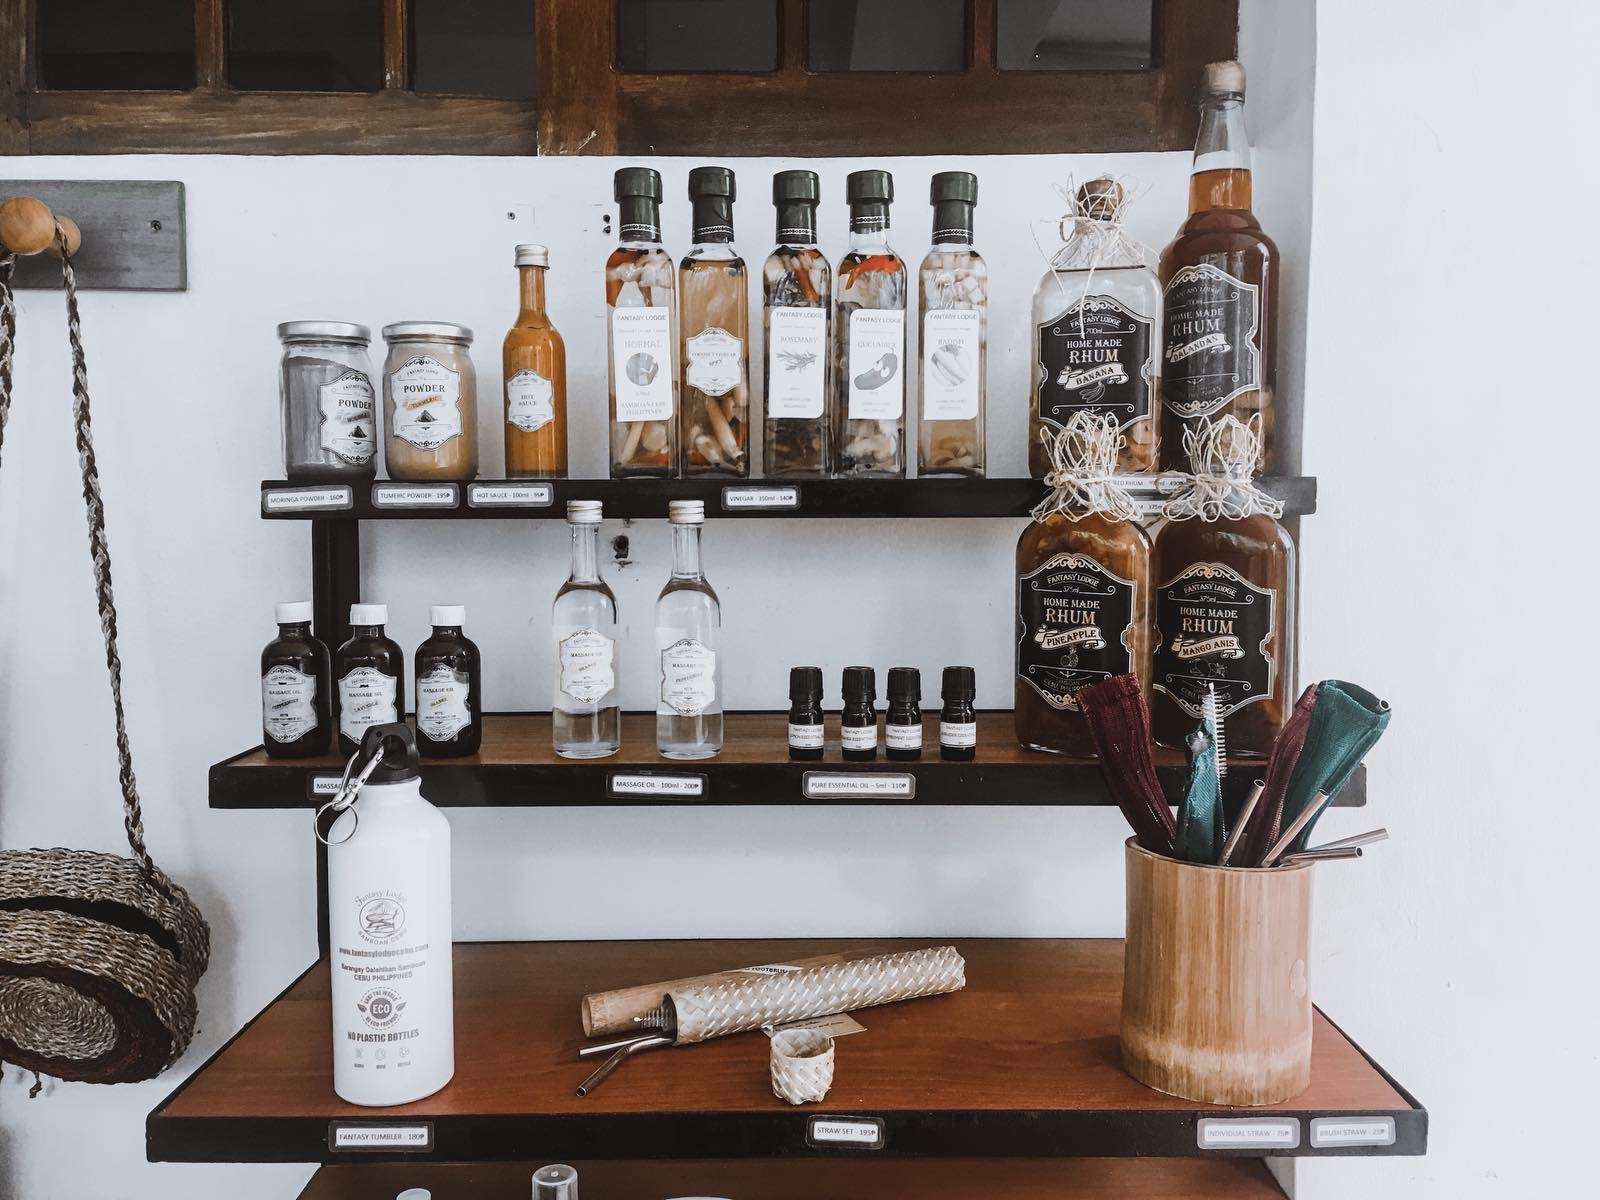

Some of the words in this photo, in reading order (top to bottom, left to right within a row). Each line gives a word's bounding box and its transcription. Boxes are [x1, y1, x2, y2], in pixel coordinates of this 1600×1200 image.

[804, 311, 824, 319] LODGE
[1070, 315, 1100, 328] FATASY
[1100, 315, 1121, 327] LODGE
[1170, 311, 1193, 323] HOME
[1195, 308, 1224, 318] MADE
[1173, 318, 1220, 337] RHUM
[780, 336, 817, 344] ROSEMARY
[1067, 340, 1092, 348] HOME
[1095, 339, 1122, 348] MADE
[1069, 349, 1119, 363] RHUM
[1076, 366, 1114, 385] BANANA
[403, 384, 445, 393] POWDER
[338, 399, 372, 410] POWDER
[270, 496, 299, 504] MORINGA
[1047, 573, 1078, 585] FANTASY
[1077, 574, 1100, 587] LODGE
[1184, 583, 1214, 594] FANTASY
[1213, 584, 1237, 597] LODGE
[1043, 597, 1069, 607] HOME
[1071, 600, 1100, 609] MADE
[1045, 608, 1096, 625] RHUM
[1180, 607, 1206, 617] HOME
[1208, 609, 1238, 618] MADE
[1182, 618, 1233, 634] RHUM
[1046, 629, 1097, 646] PINEAPPLE
[1182, 643, 1211, 656] MANGO
[1213, 638, 1235, 649] ANIS
[372, 971, 413, 981] PHILIPPINES
[372, 1003, 391, 1014] ECO
[347, 1031, 356, 1041] NO
[357, 1033, 386, 1042] PLASTIC
[387, 1029, 420, 1041] BOTTLES
